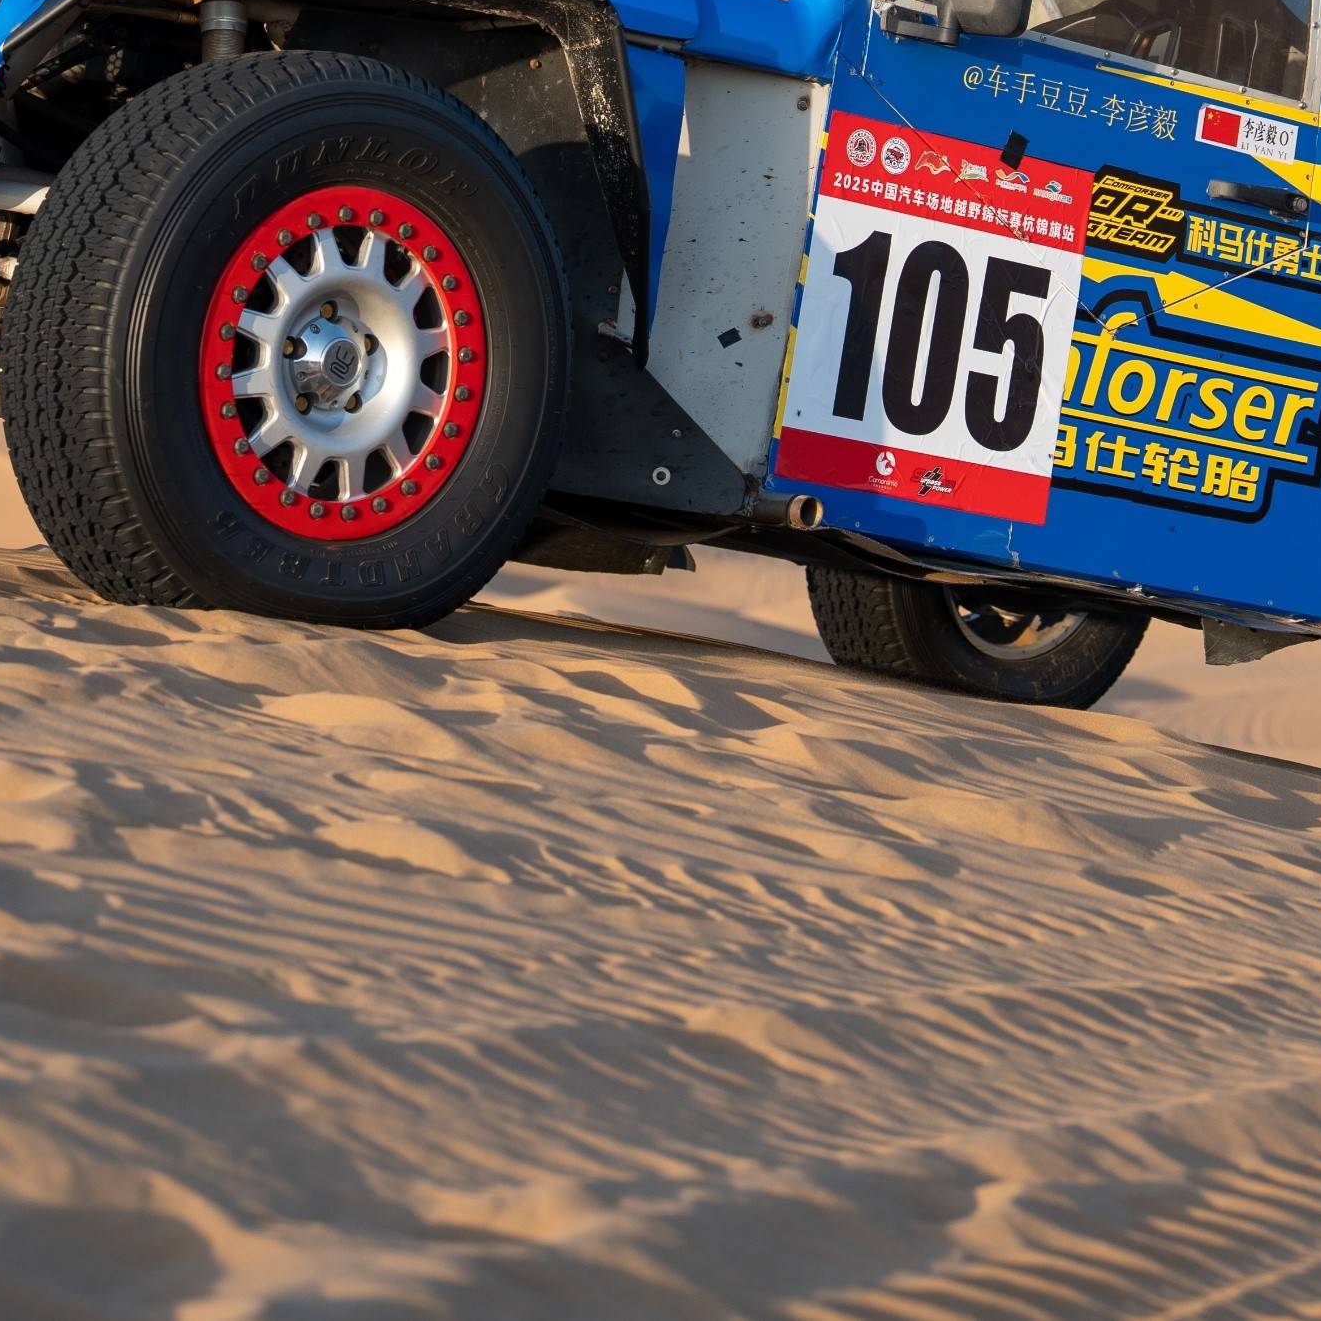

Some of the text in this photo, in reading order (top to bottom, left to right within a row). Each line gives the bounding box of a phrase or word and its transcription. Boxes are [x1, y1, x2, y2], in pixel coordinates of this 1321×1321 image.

[233, 134, 480, 221] DUNLOP
[1241, 141, 1252, 152] LI
[1254, 144, 1273, 156] YAN
[833, 230, 1052, 452] 105
[1062, 312, 1315, 446] forser
[1053, 423, 1261, 503] 仕轮胎
[208, 462, 510, 587] GRANDTREK
